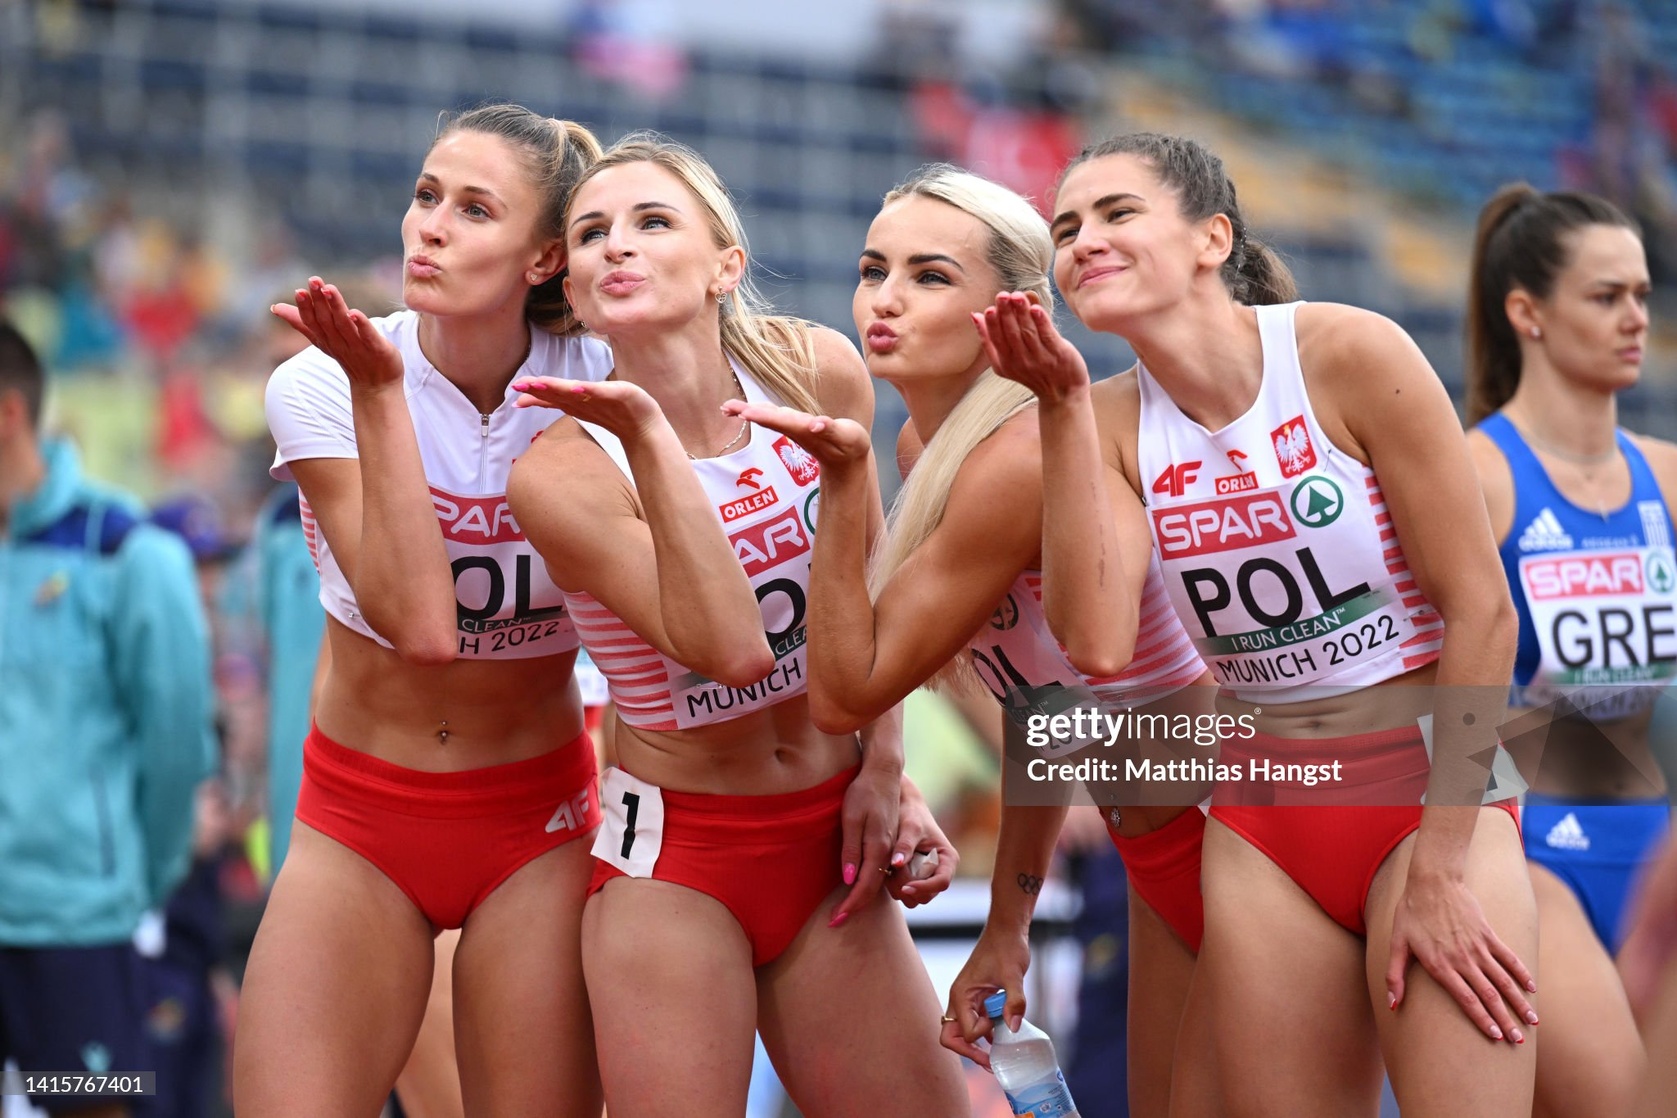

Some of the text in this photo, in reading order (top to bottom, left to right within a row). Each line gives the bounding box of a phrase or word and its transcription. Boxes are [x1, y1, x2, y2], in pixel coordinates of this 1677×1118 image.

[1152, 460, 1202, 497] 4F
[1217, 474, 1256, 494] ORLN
[431, 495, 521, 538] PAR
[724, 489, 775, 519] ORLEN
[1160, 500, 1289, 552] SPAR
[734, 517, 804, 563] AR
[450, 555, 563, 620] OL
[1180, 546, 1371, 638] POL
[1528, 557, 1642, 596] SPAR
[491, 621, 560, 652] 2022
[1216, 614, 1400, 684] MUNICH 2022
[1240, 631, 1277, 650] RUN
[1552, 604, 1677, 669] GRE
[686, 657, 802, 718] MUNICH
[971, 644, 1067, 710] OL
[545, 788, 590, 834] 4F
[621, 791, 641, 860] 1
